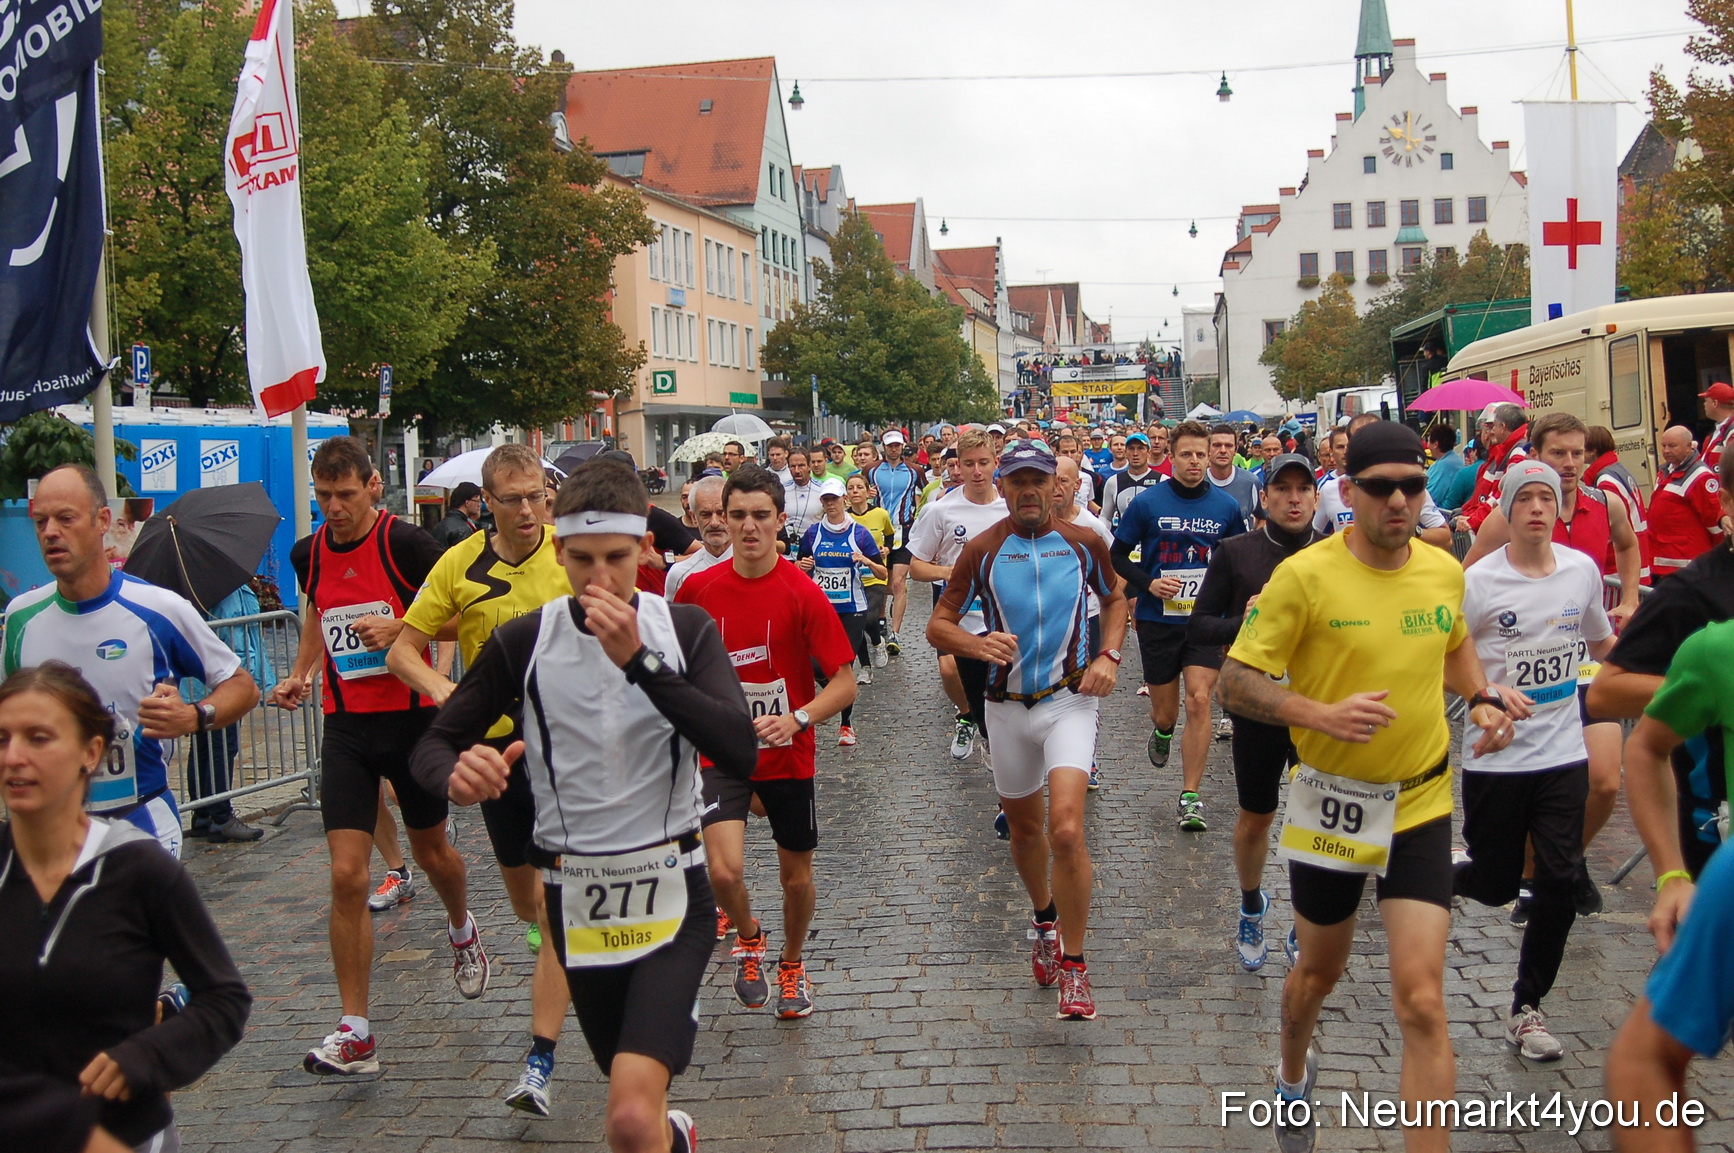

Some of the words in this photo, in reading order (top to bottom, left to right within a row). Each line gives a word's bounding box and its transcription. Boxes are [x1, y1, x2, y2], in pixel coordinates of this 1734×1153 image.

[136, 353, 146, 380] P
[1529, 357, 1581, 387] Bayerisches
[382, 371, 390, 387] P
[656, 374, 672, 391] D
[1082, 384, 1115, 393] START
[1529, 390, 1554, 410] Rotes
[1192, 518, 1221, 530] HiRo
[818, 576, 847, 590] 2364
[322, 614, 345, 623] PARTL
[345, 609, 379, 620] Neumarkt
[1404, 612, 1434, 629] BIKE
[736, 651, 756, 661] DEHN
[1507, 649, 1535, 659] PARTL
[1536, 643, 1569, 656] Neumarkt
[347, 655, 379, 669] Stefan
[1516, 651, 1573, 687] 2637
[1531, 688, 1563, 701] Florian
[1295, 772, 1327, 791] PARTL
[1329, 784, 1379, 800] Neumarkt
[1320, 796, 1364, 835] 99
[1312, 835, 1356, 859] Stefan
[563, 866, 600, 879] PARTL
[601, 860, 661, 878] Neumarkt
[585, 876, 660, 921] 277
[601, 929, 653, 948] Tobias
